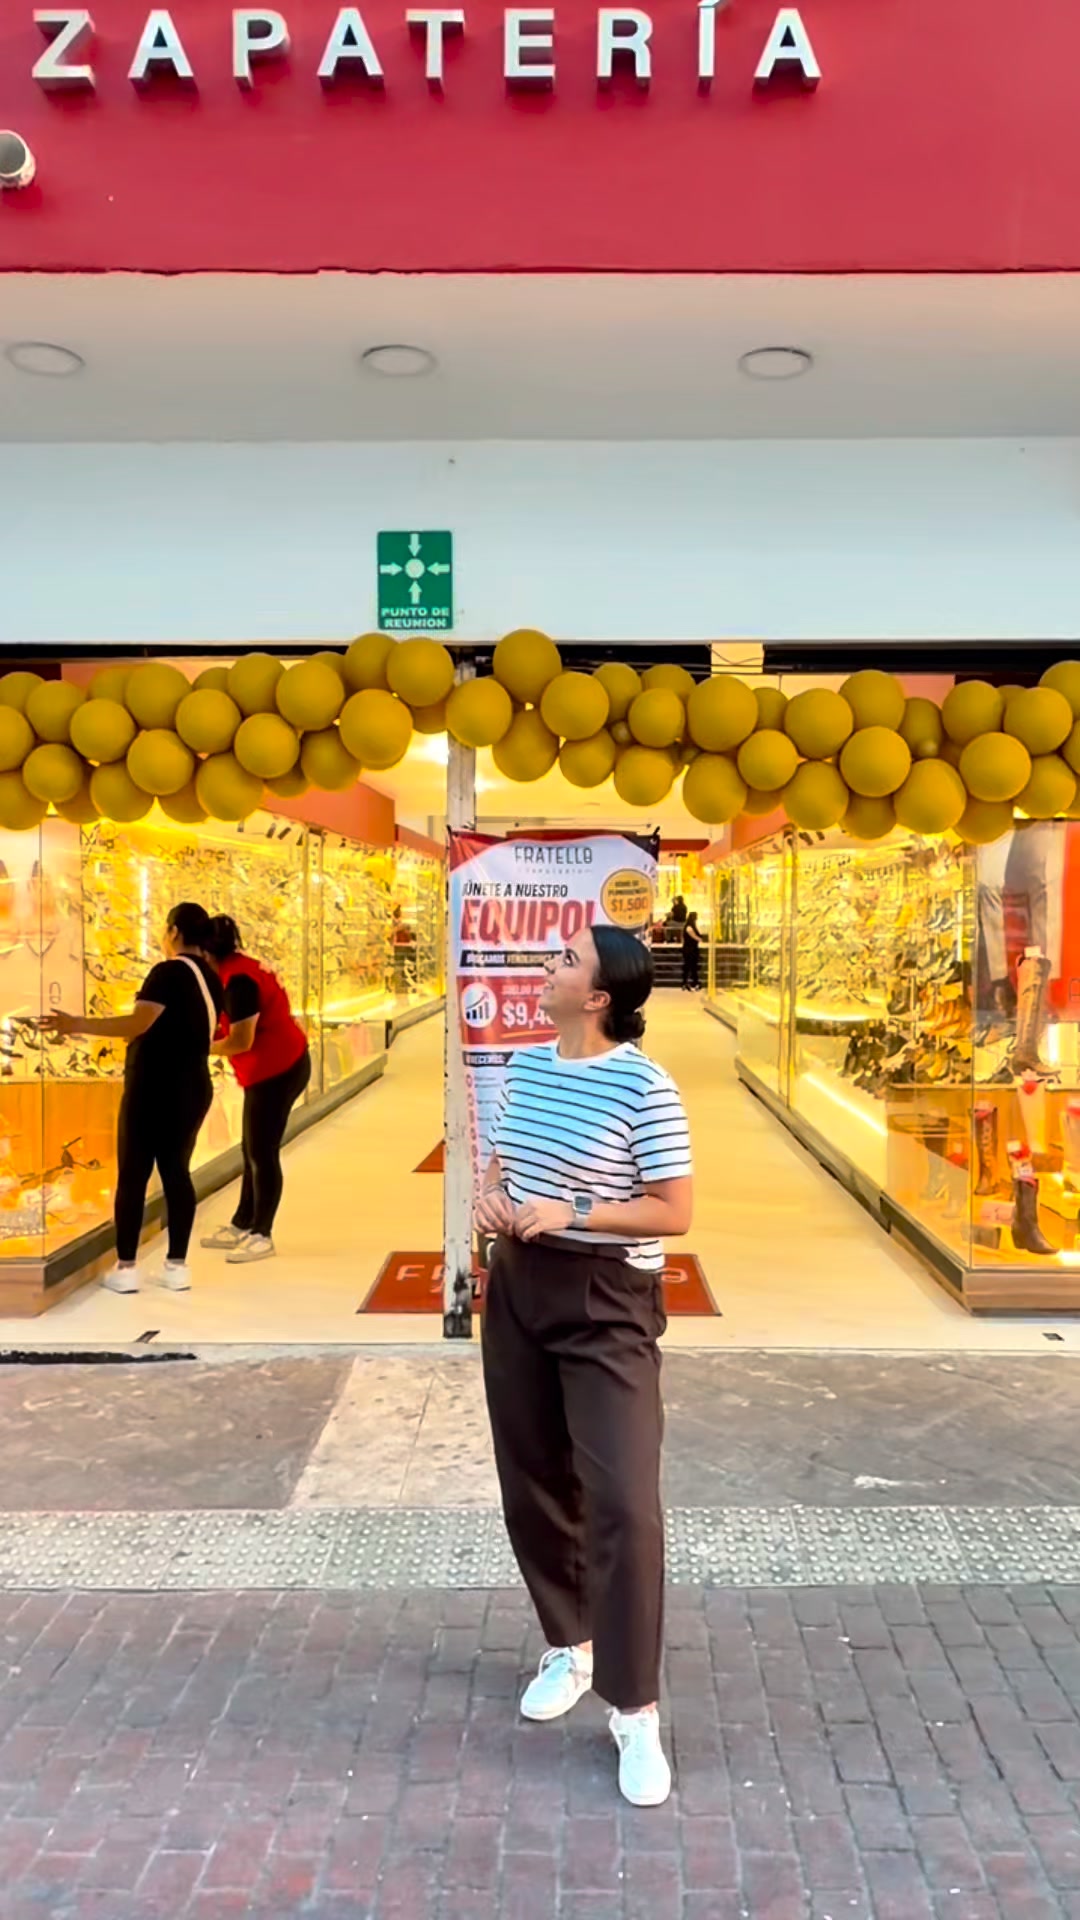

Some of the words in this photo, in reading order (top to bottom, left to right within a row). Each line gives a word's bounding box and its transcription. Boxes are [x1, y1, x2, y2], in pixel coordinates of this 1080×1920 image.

[32, 0, 821, 88] ZAPATERÍA
[381, 607, 428, 617] PUNTO
[431, 607, 449, 617] DE
[384, 618, 446, 628] REUNION
[514, 846, 593, 864] FRATELLO
[503, 883, 513, 897] A
[515, 884, 568, 897] NUESTRO
[611, 897, 649, 912] $1,500
